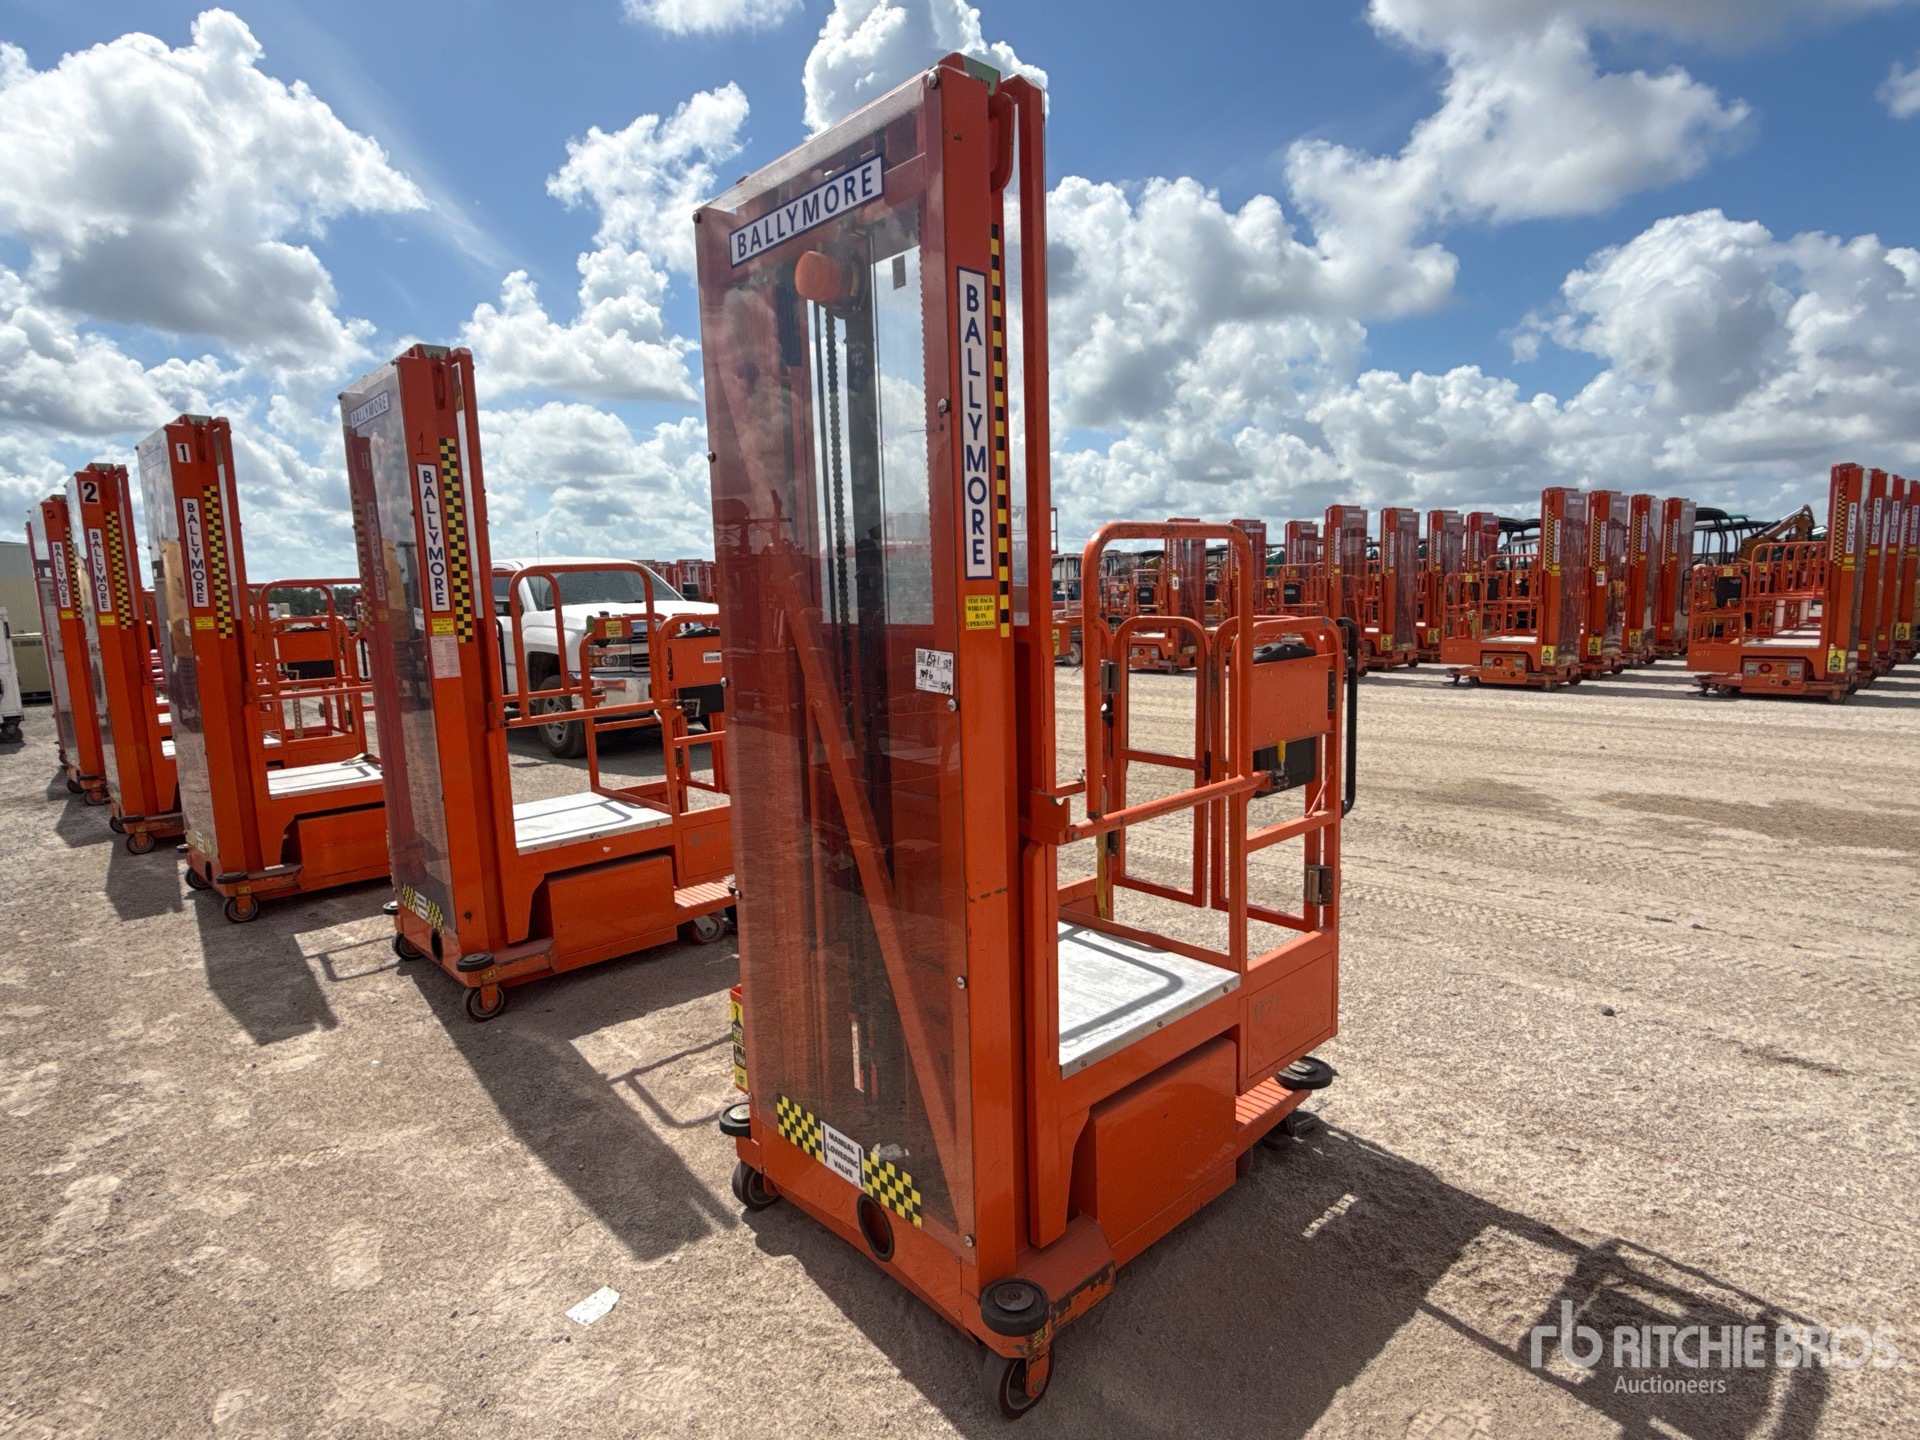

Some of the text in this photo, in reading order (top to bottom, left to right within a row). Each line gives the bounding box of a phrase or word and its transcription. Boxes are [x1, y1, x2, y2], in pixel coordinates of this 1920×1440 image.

[737, 166, 873, 258] BALLYMORE
[352, 395, 388, 424] BALLYMORE
[964, 284, 987, 565] BALLYMORE
[179, 444, 187, 462] 1
[83, 482, 98, 503] 2
[423, 470, 445, 605] BALLYMORE
[1847, 504, 1856, 552] BALLYMORE
[54, 543, 68, 606] BALLYMORE
[91, 531, 108, 609] BALLYMORE
[187, 502, 205, 603] BALLYMORE
[826, 1142, 859, 1169] LOWERING
[828, 1131, 855, 1155] MANUAL
[833, 1159, 853, 1178] VALVE
